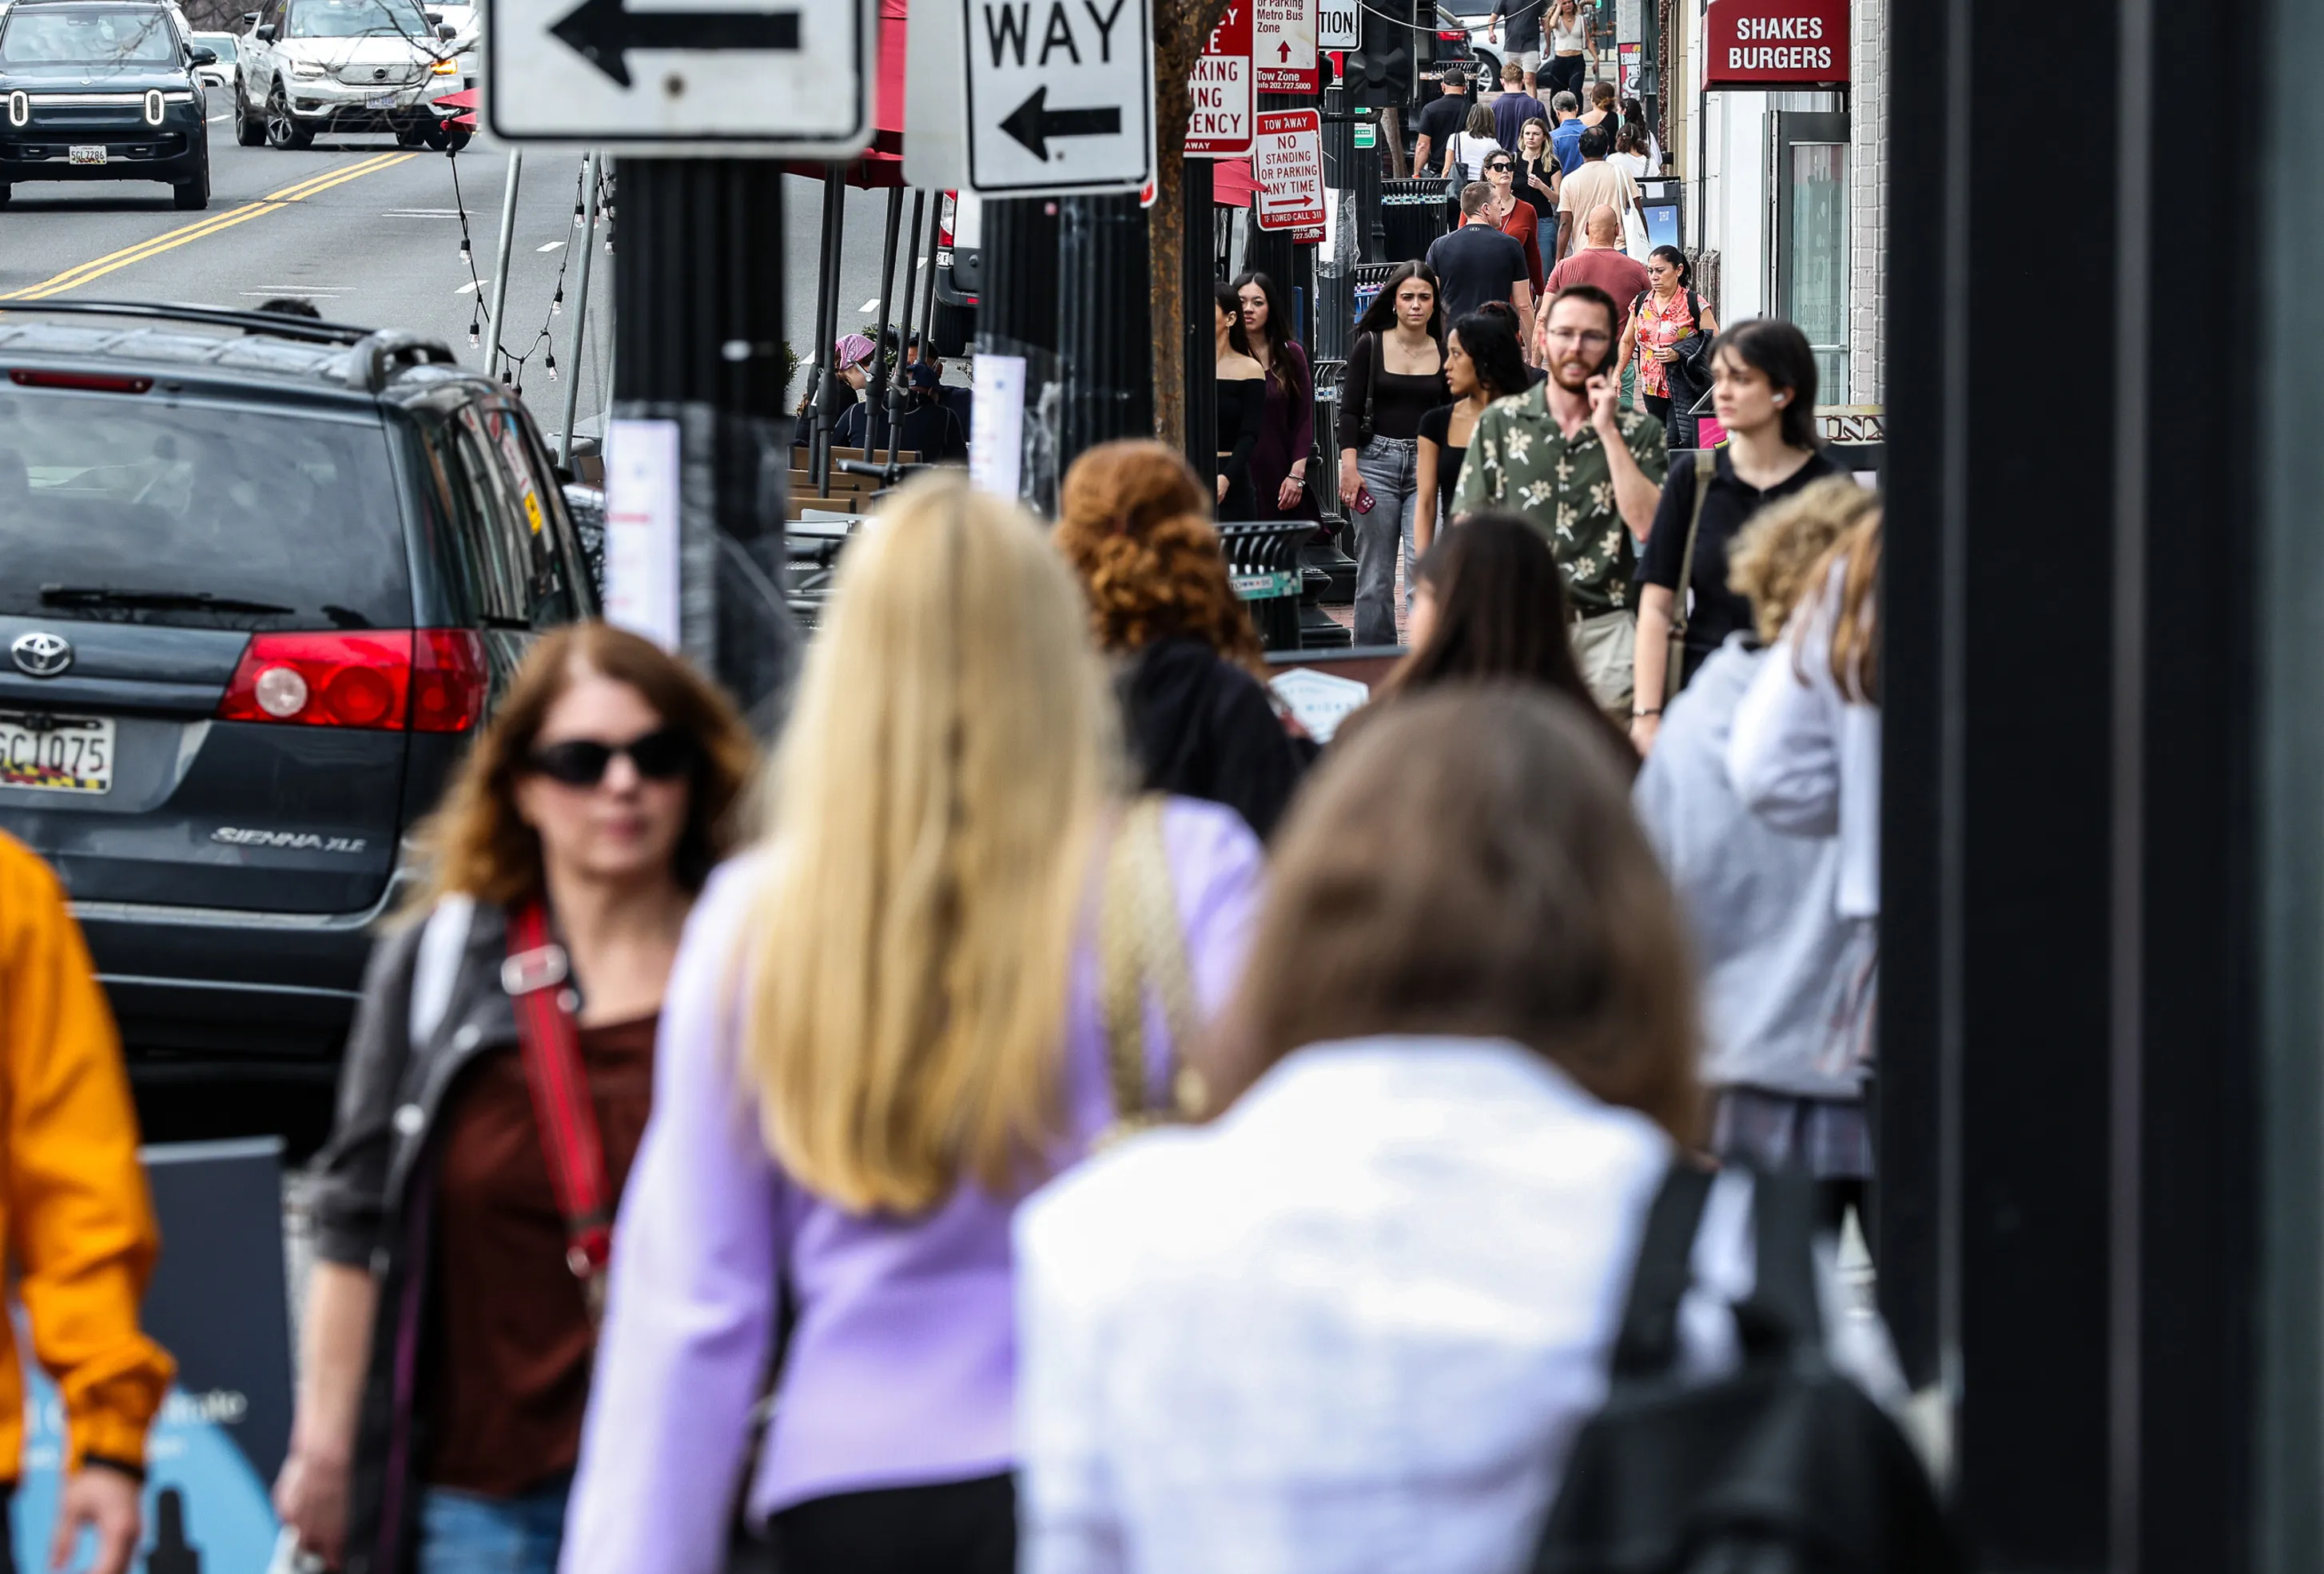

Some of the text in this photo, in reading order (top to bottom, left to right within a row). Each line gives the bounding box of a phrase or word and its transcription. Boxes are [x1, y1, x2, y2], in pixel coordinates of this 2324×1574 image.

[1270, 0, 1303, 10] Parking
[1257, 9, 1303, 21] Metro Bus
[1319, 10, 1353, 34] TION
[984, 0, 1126, 69] WAY
[1257, 22, 1280, 33] Zone
[1737, 17, 1823, 40] SHAKES
[1729, 46, 1832, 70] BURGERS
[1257, 70, 1299, 81] Tow Zone
[1269, 81, 1311, 90] 202.727.5000
[1264, 117, 1307, 130] TOW AWAY
[1277, 135, 1296, 150] NO
[1266, 150, 1311, 165] STANDING
[1261, 165, 1318, 180] OR PARKING
[1266, 180, 1315, 196] ANY TIME
[1271, 213, 1292, 222] TOWED
[1292, 212, 1310, 221] CALL
[1311, 211, 1322, 220] 311
[210, 827, 368, 853] SIENNA XLE
